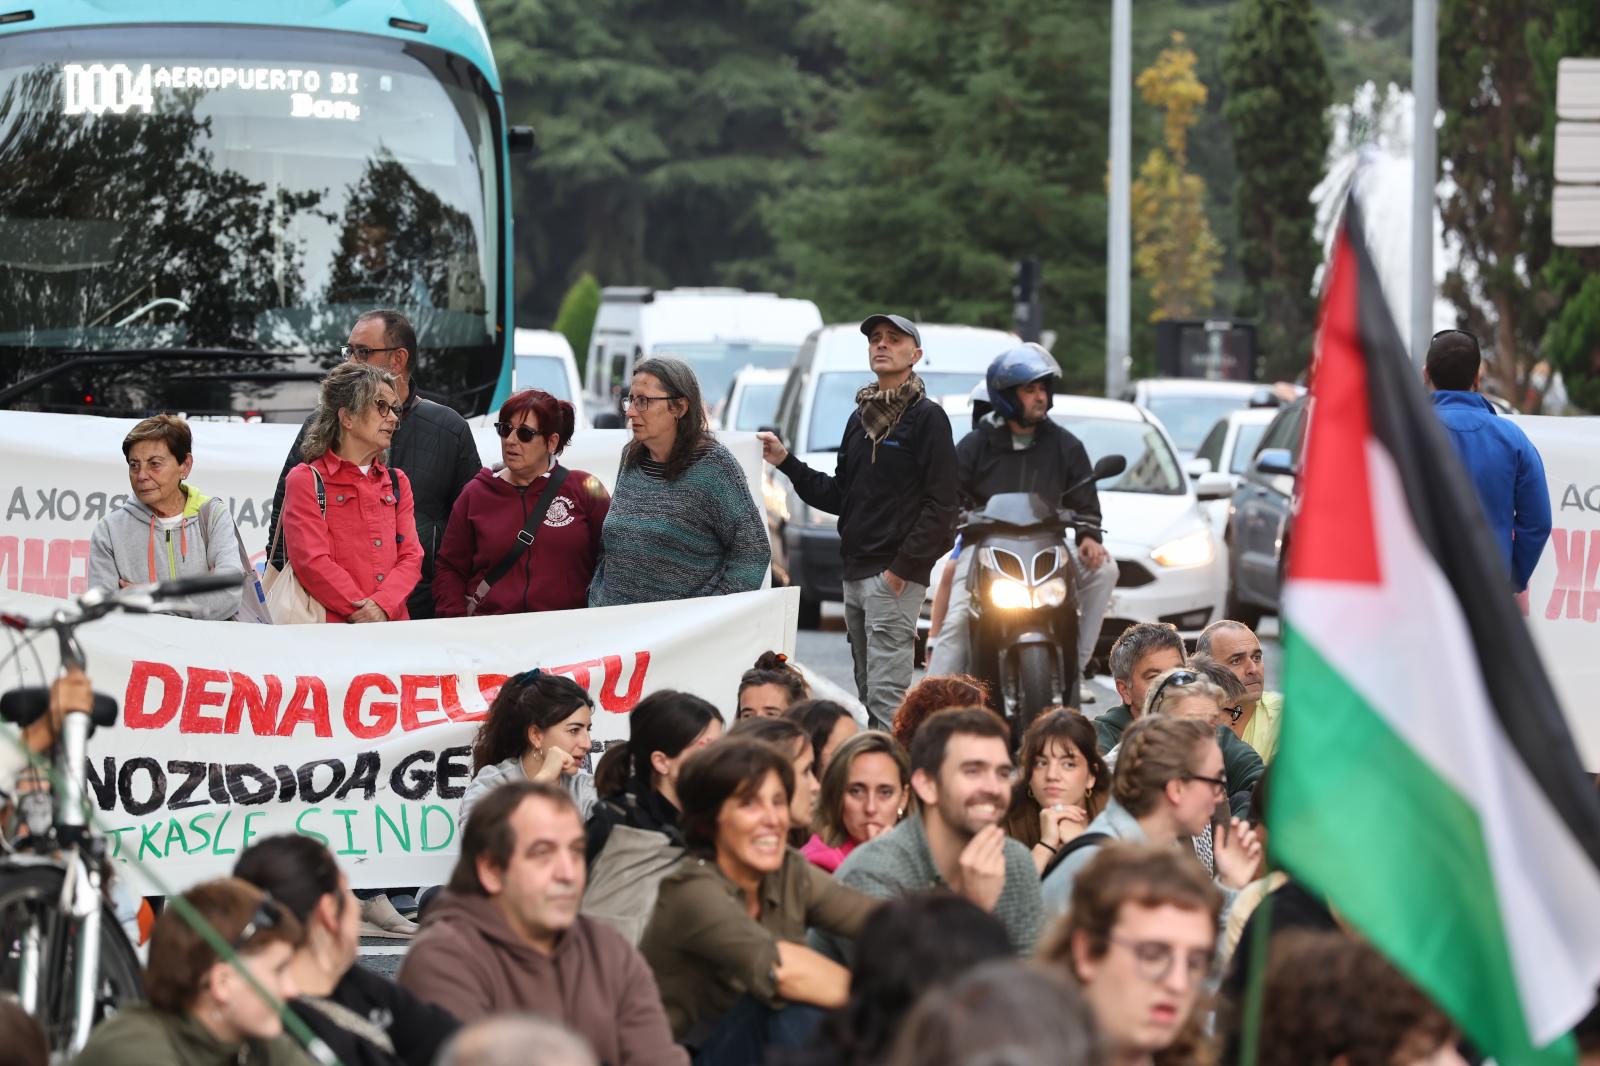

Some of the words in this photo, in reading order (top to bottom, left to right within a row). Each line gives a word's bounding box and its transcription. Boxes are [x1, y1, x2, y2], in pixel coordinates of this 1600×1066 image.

[154, 67, 320, 91] AEROPUERTO
[124, 660, 332, 738] DENA
[85, 750, 381, 816] NOZIDIOA
[295, 803, 454, 857] SIND
